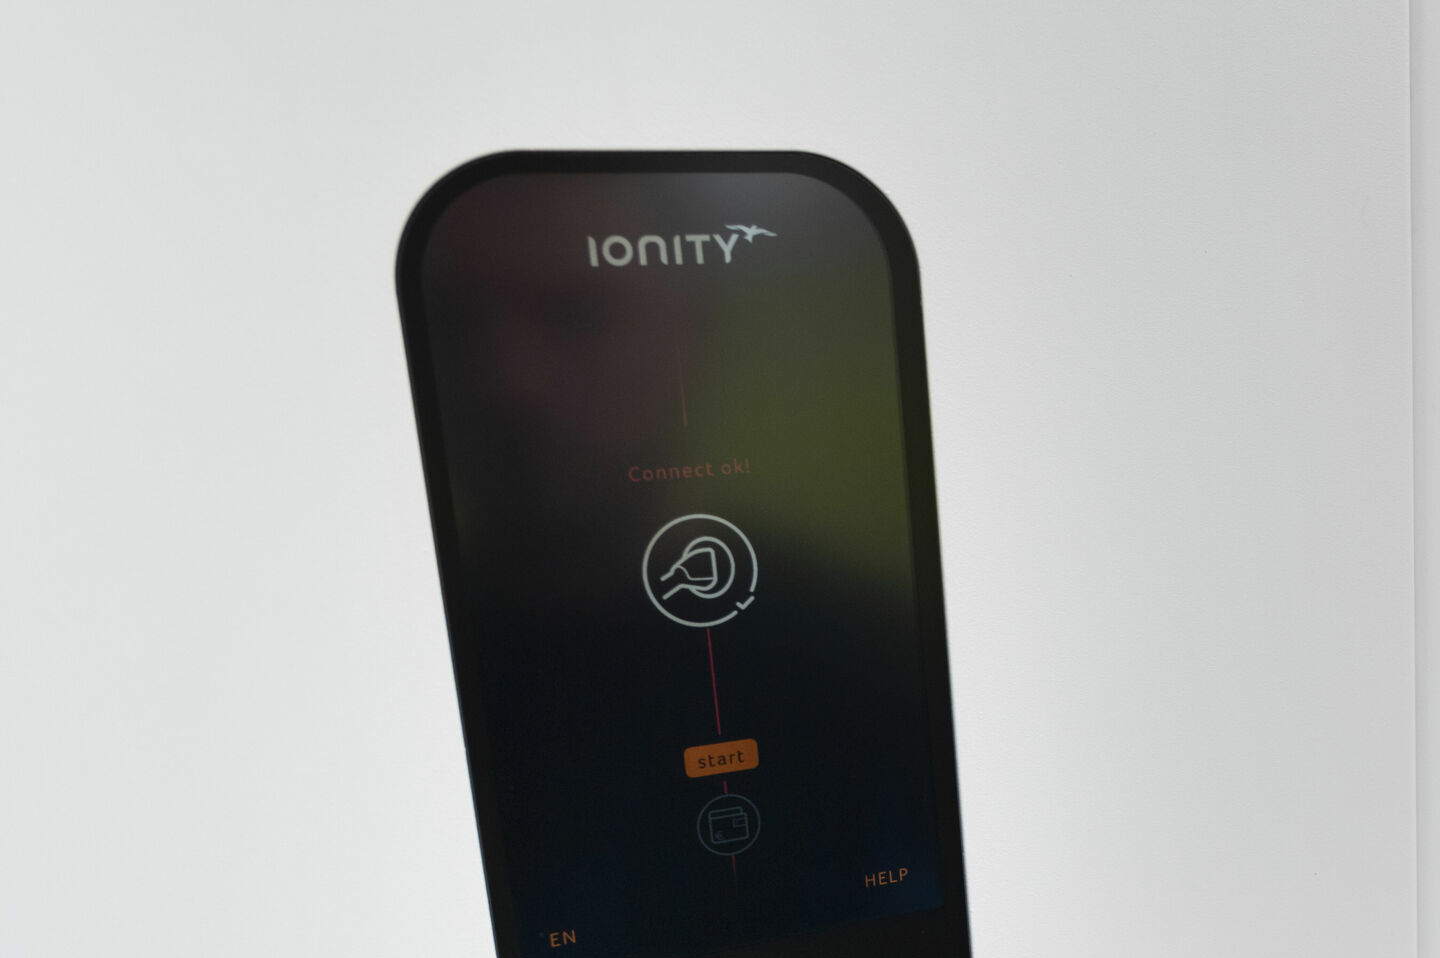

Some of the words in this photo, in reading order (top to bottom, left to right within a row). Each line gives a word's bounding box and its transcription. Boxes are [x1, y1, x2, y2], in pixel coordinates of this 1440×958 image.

[586, 233, 740, 268] IONITY
[628, 462, 714, 482] Connect
[721, 458, 751, 476] ok!
[698, 749, 746, 770] start
[864, 867, 910, 889] HELP
[550, 929, 578, 949] EN
